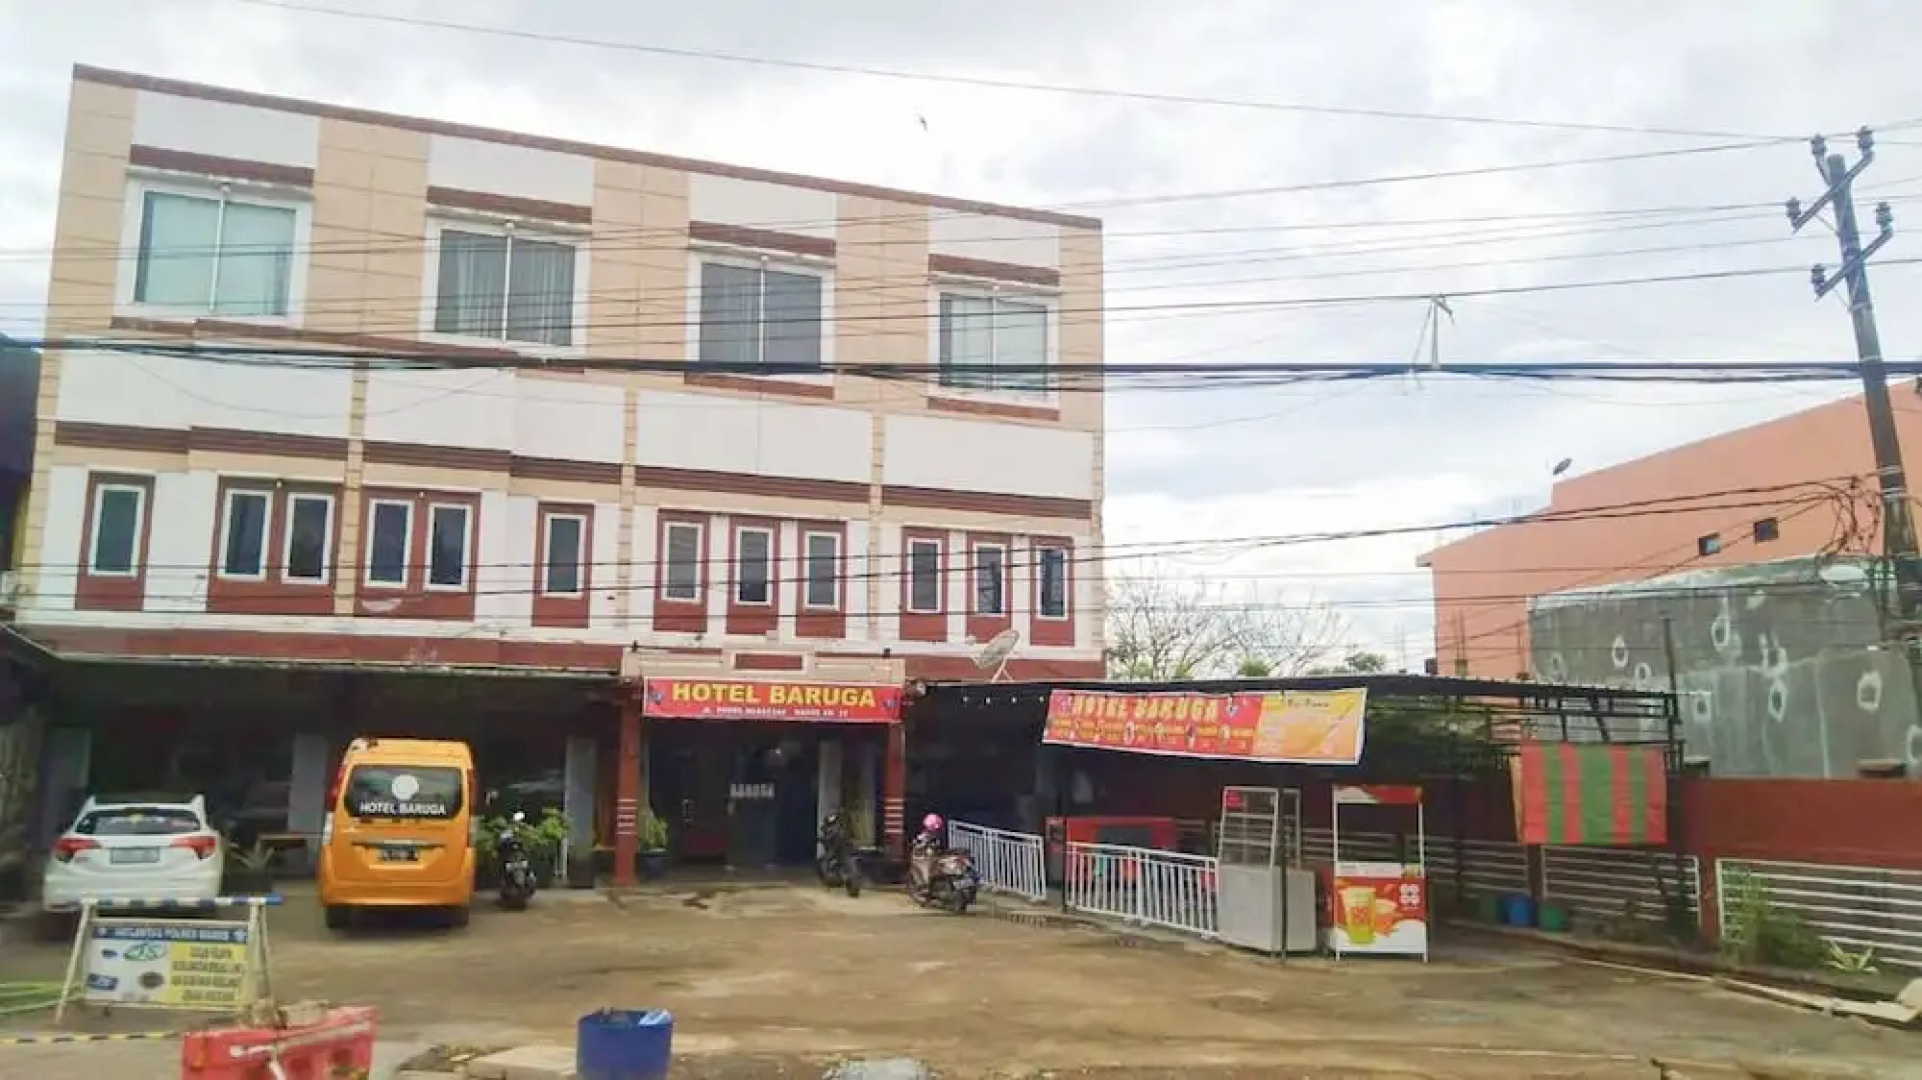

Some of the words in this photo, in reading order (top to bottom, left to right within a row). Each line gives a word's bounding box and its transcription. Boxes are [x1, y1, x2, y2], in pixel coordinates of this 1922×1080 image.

[672, 683, 762, 704] HOTEL
[769, 685, 876, 708] BARUGA
[1072, 694, 1126, 717] HOTEL
[1133, 696, 1219, 722] BARUGA
[359, 801, 395, 815] HOTEL
[398, 802, 447, 816] BARUGA
